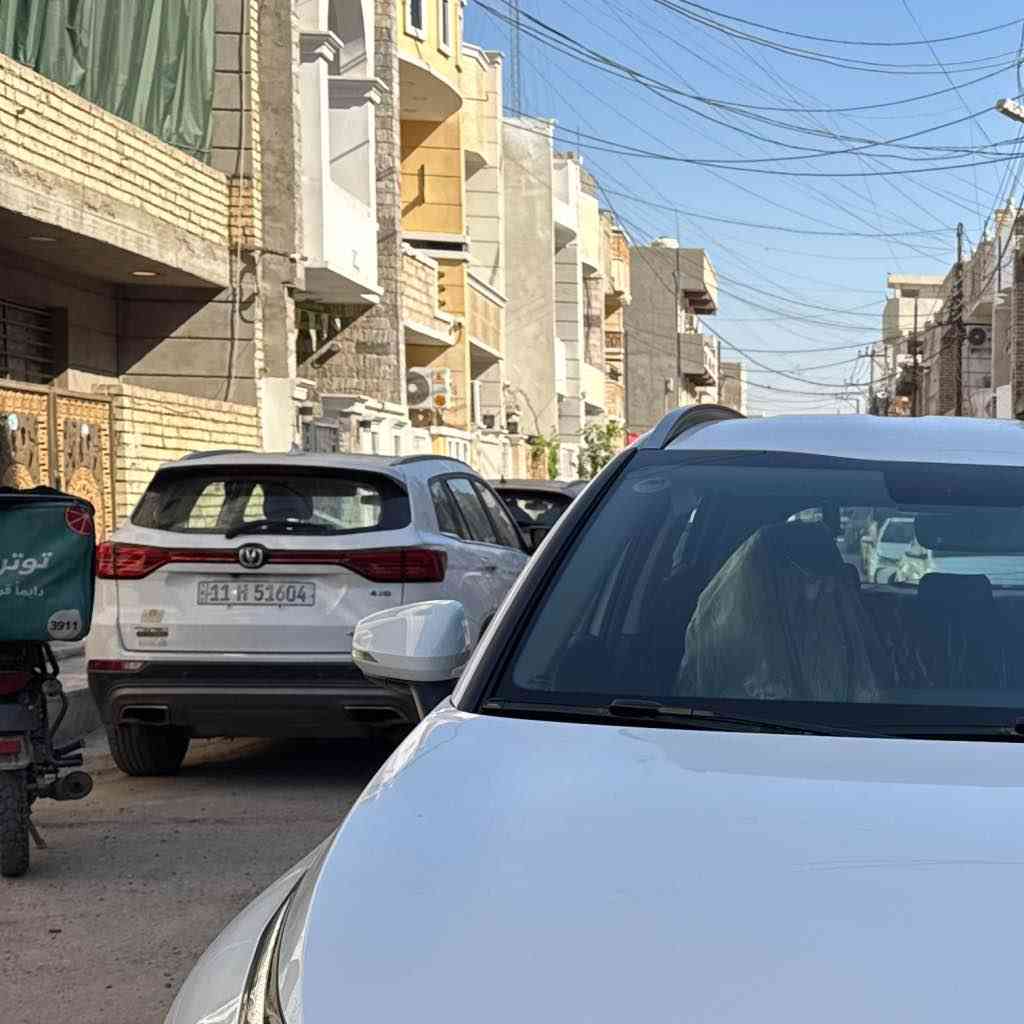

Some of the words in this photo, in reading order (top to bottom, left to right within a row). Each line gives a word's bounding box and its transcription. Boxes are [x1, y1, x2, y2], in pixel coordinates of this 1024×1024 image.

[210, 583, 231, 602] 11
[254, 583, 307, 603] 51604
[49, 620, 78, 631] 3911
